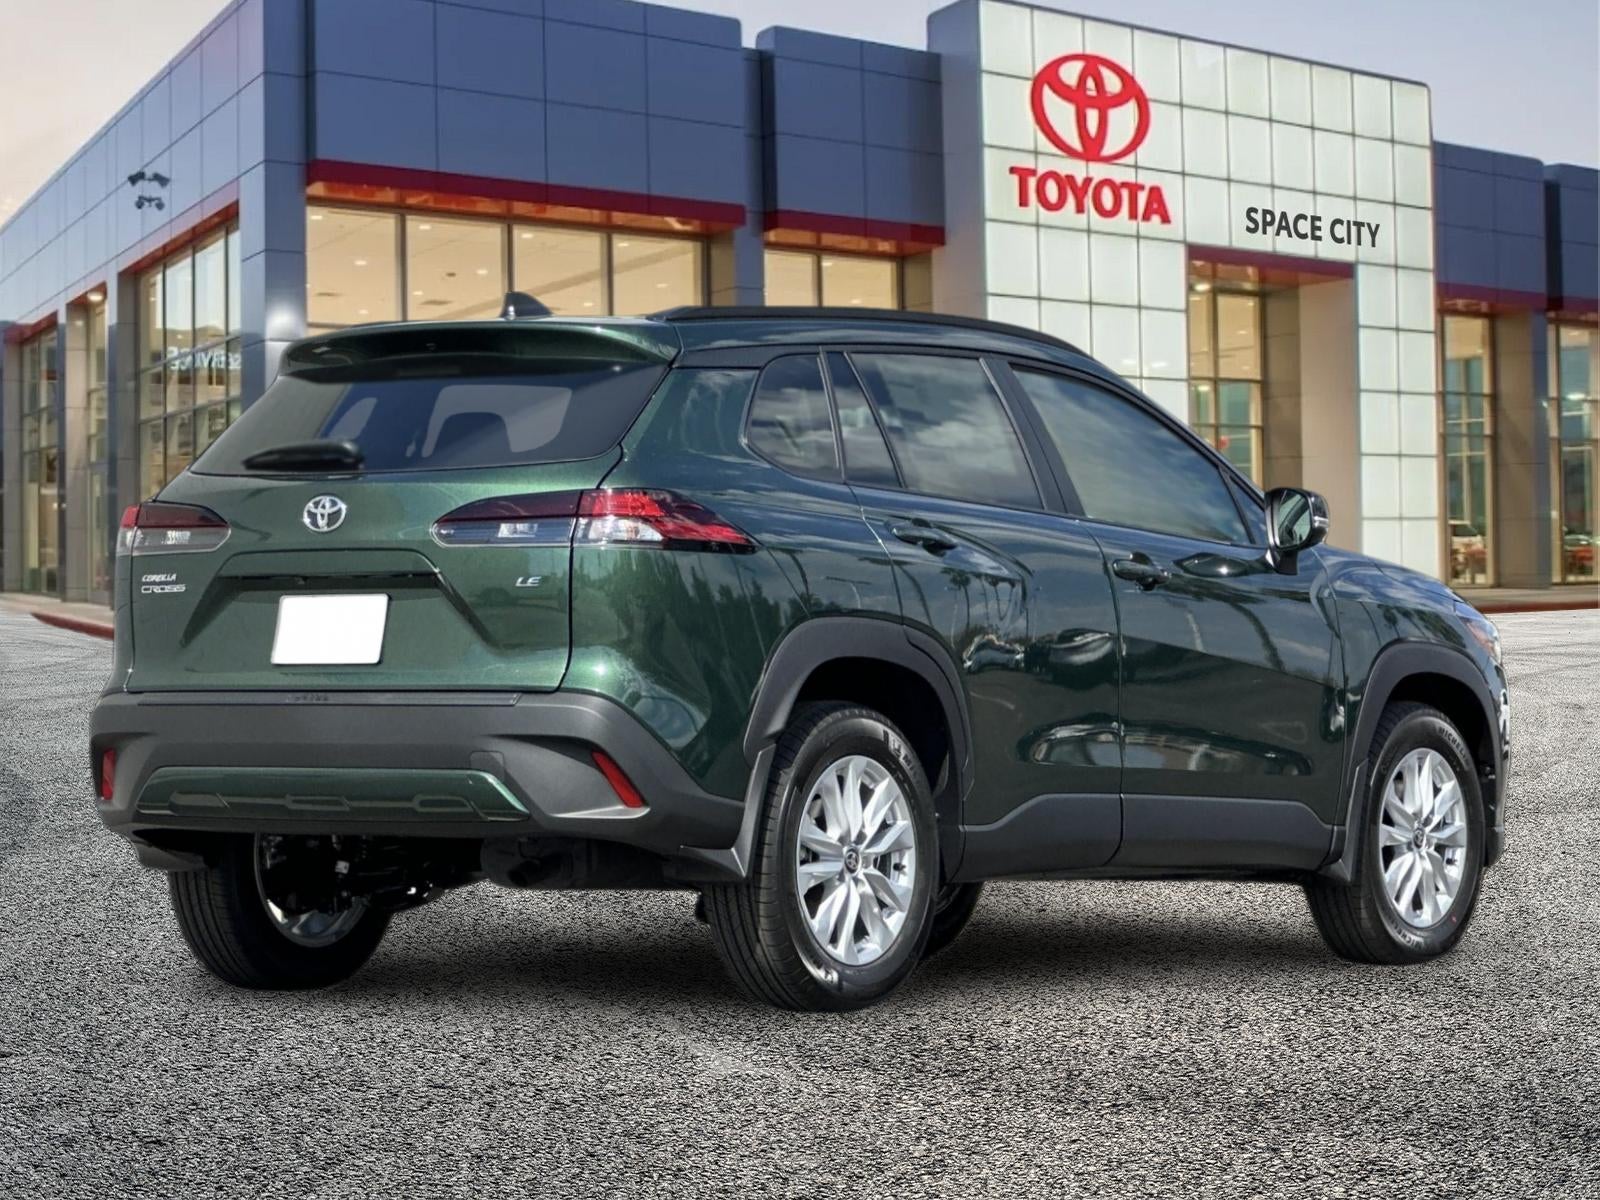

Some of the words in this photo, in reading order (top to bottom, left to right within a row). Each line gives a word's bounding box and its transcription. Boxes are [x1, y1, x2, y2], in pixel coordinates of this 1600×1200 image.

[1009, 166, 1171, 224] TOYOTA
[1245, 207, 1322, 241] SPACE
[1330, 218, 1381, 247] CITY
[142, 573, 177, 582] COROLLA
[515, 576, 542, 587] LE
[141, 584, 186, 593] CROSS
